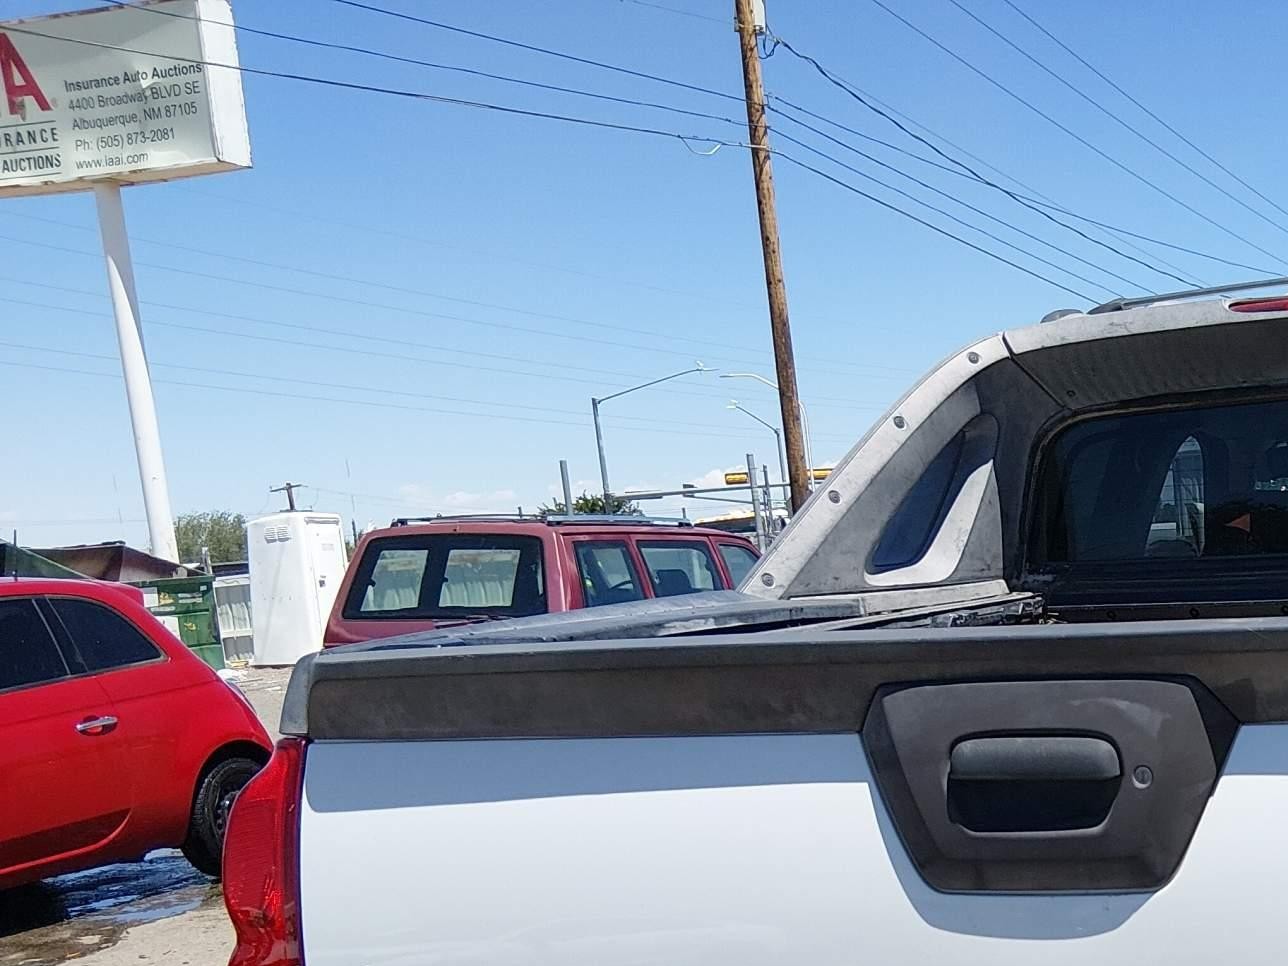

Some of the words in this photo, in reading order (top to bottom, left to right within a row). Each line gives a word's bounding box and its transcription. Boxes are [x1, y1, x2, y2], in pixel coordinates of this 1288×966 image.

[64, 75, 120, 93] Insurance
[123, 69, 147, 83] Auto
[151, 63, 202, 79] Auctions
[68, 96, 97, 112] 4400
[98, 90, 147, 108] Broadway
[151, 84, 182, 101] BLVD
[184, 80, 200, 95] SE
[72, 114, 141, 131] Albuquerque,
[143, 107, 162, 121] NM
[165, 102, 198, 118] 87105
[0, 128, 59, 148] RANCE
[75, 138, 93, 152] Ph:
[96, 135, 124, 152] (505)
[127, 128, 175, 146] 873-2081
[2, 154, 62, 174] AUCTIONS
[75, 152, 149, 170] www.iaai.com
